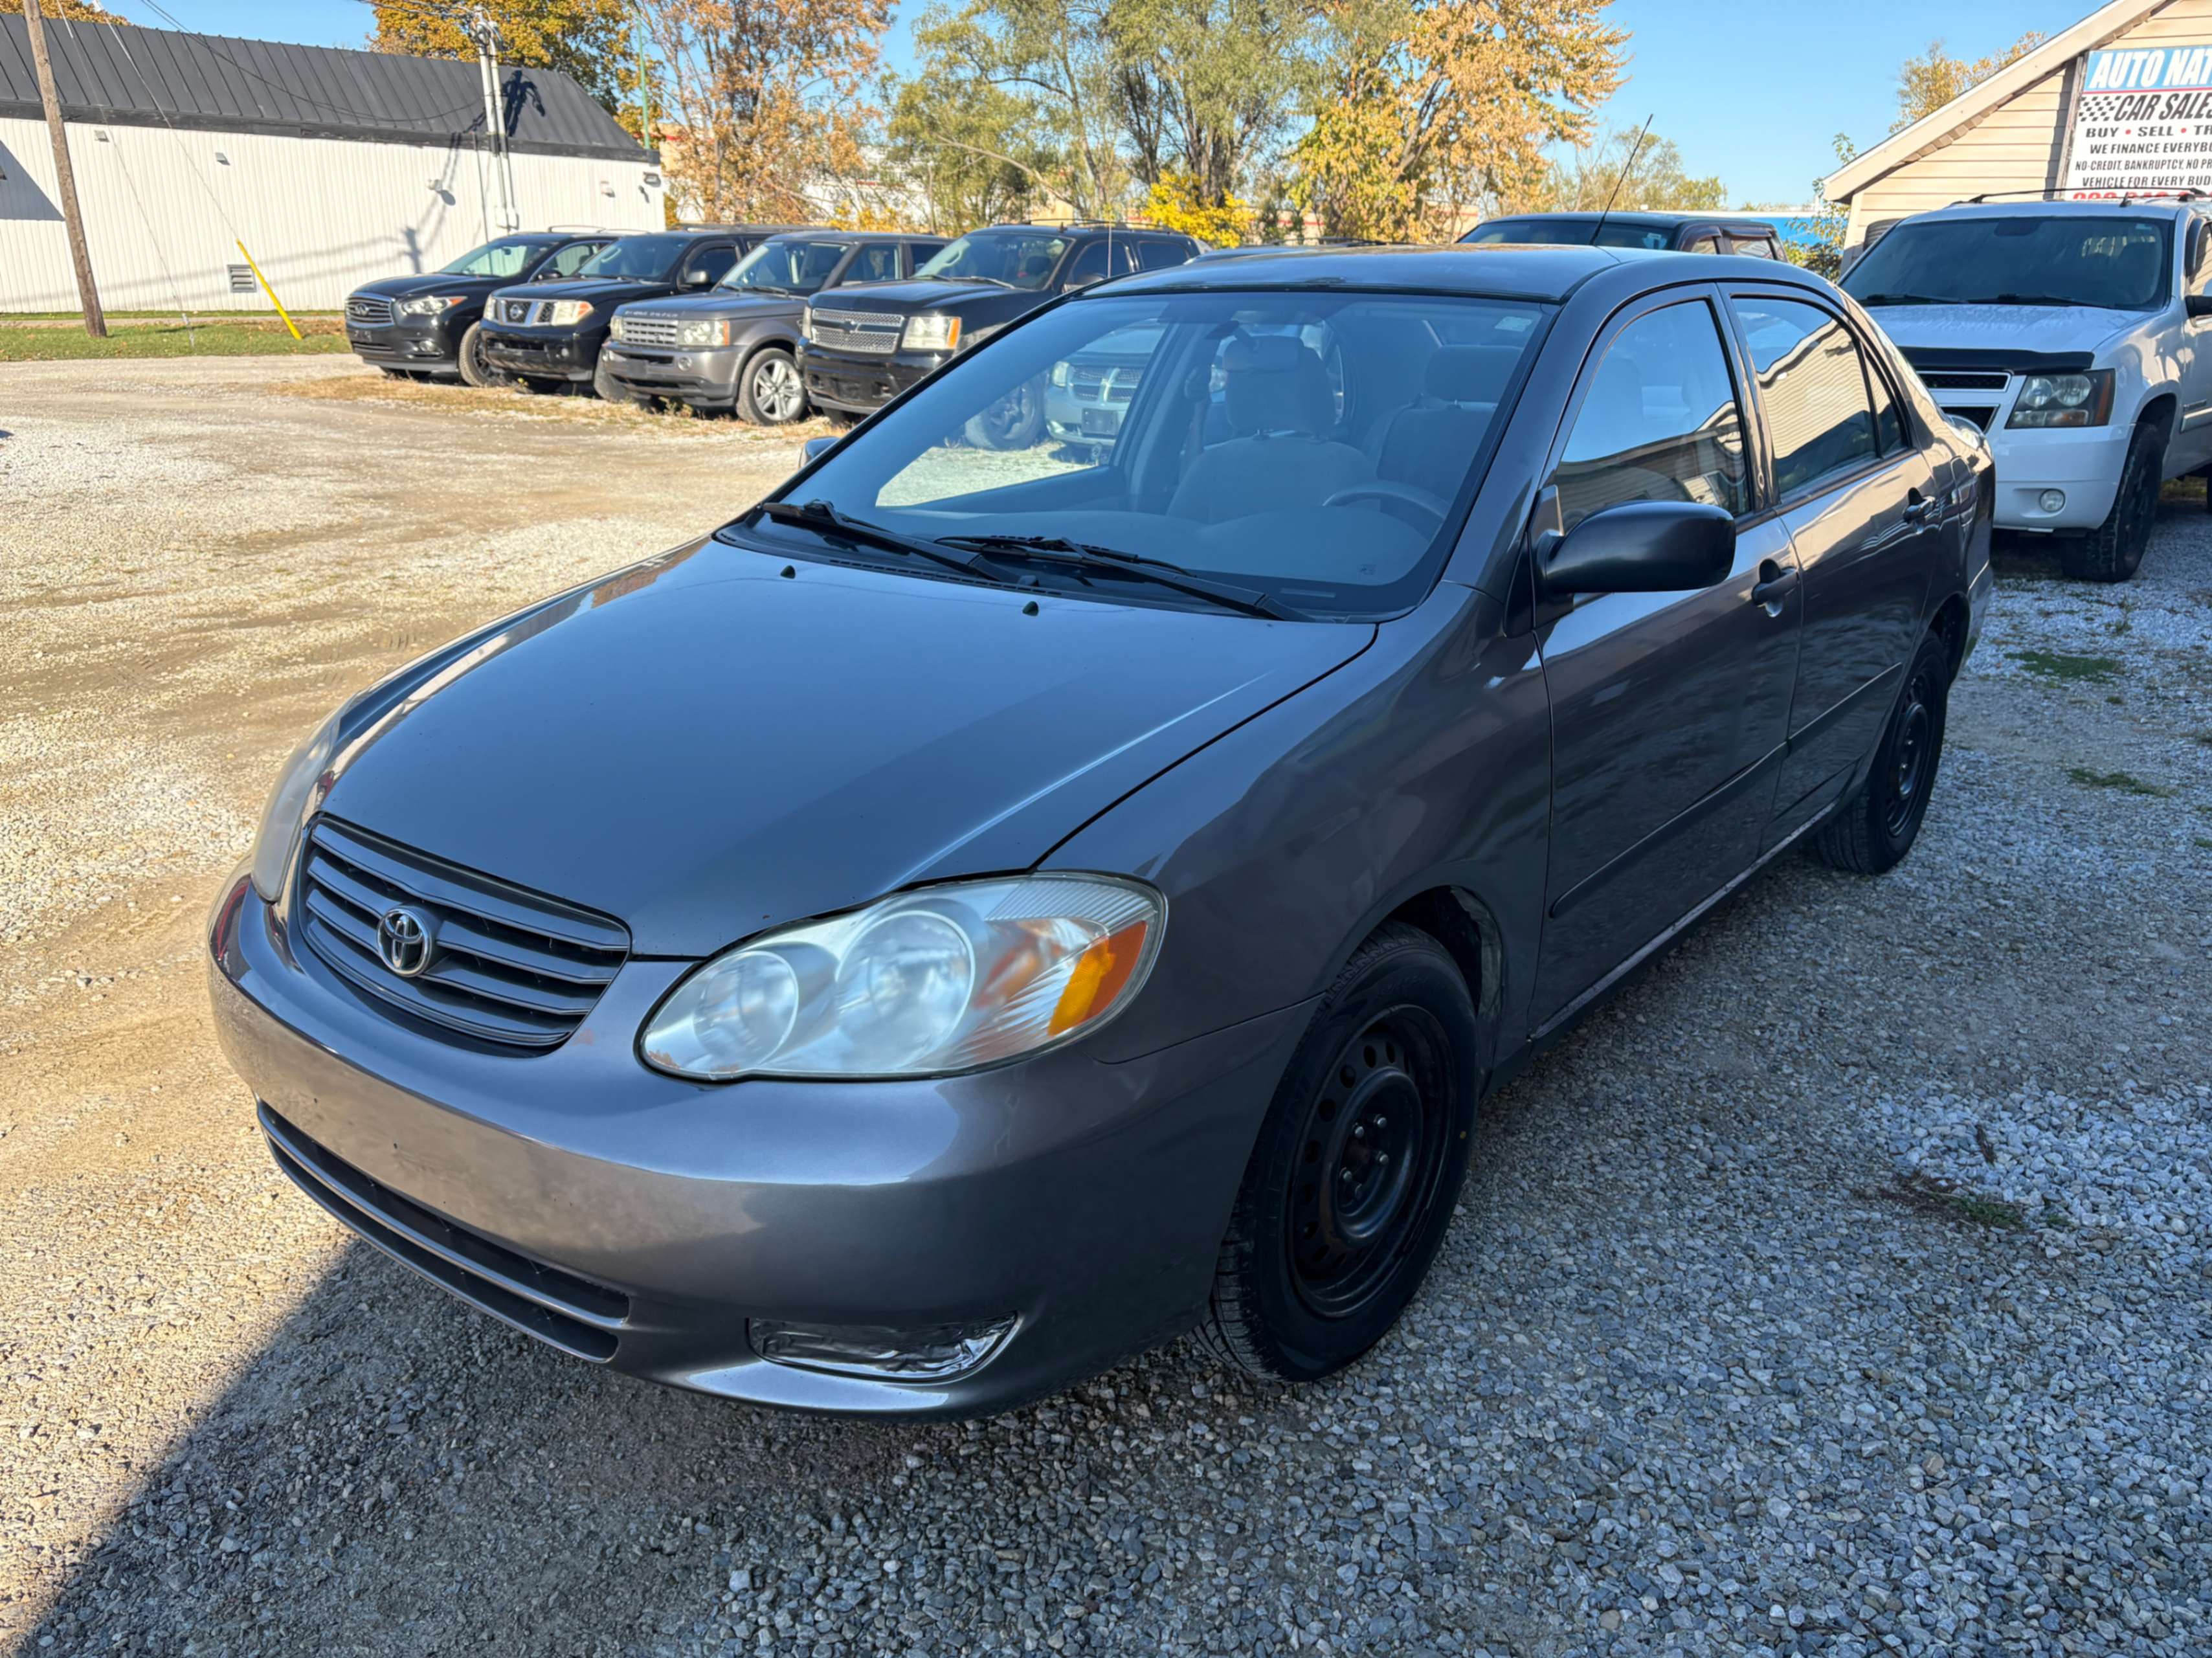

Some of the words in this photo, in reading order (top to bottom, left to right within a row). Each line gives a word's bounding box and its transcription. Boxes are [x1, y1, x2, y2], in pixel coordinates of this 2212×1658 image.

[2088, 50, 2165, 88] AUTO
[2114, 95, 2162, 121] CAR
[2086, 127, 2119, 137] BUY
[2138, 126, 2174, 137] SELL
[2090, 144, 2108, 154] WE
[2110, 142, 2160, 153] FINANCE
[2186, 159, 2198, 169] NO
[2083, 176, 2126, 187] VEHICLE
[2128, 176, 2148, 187] FOR
[2151, 175, 2184, 186] EVERY
[2187, 175, 2212, 186] BUD
